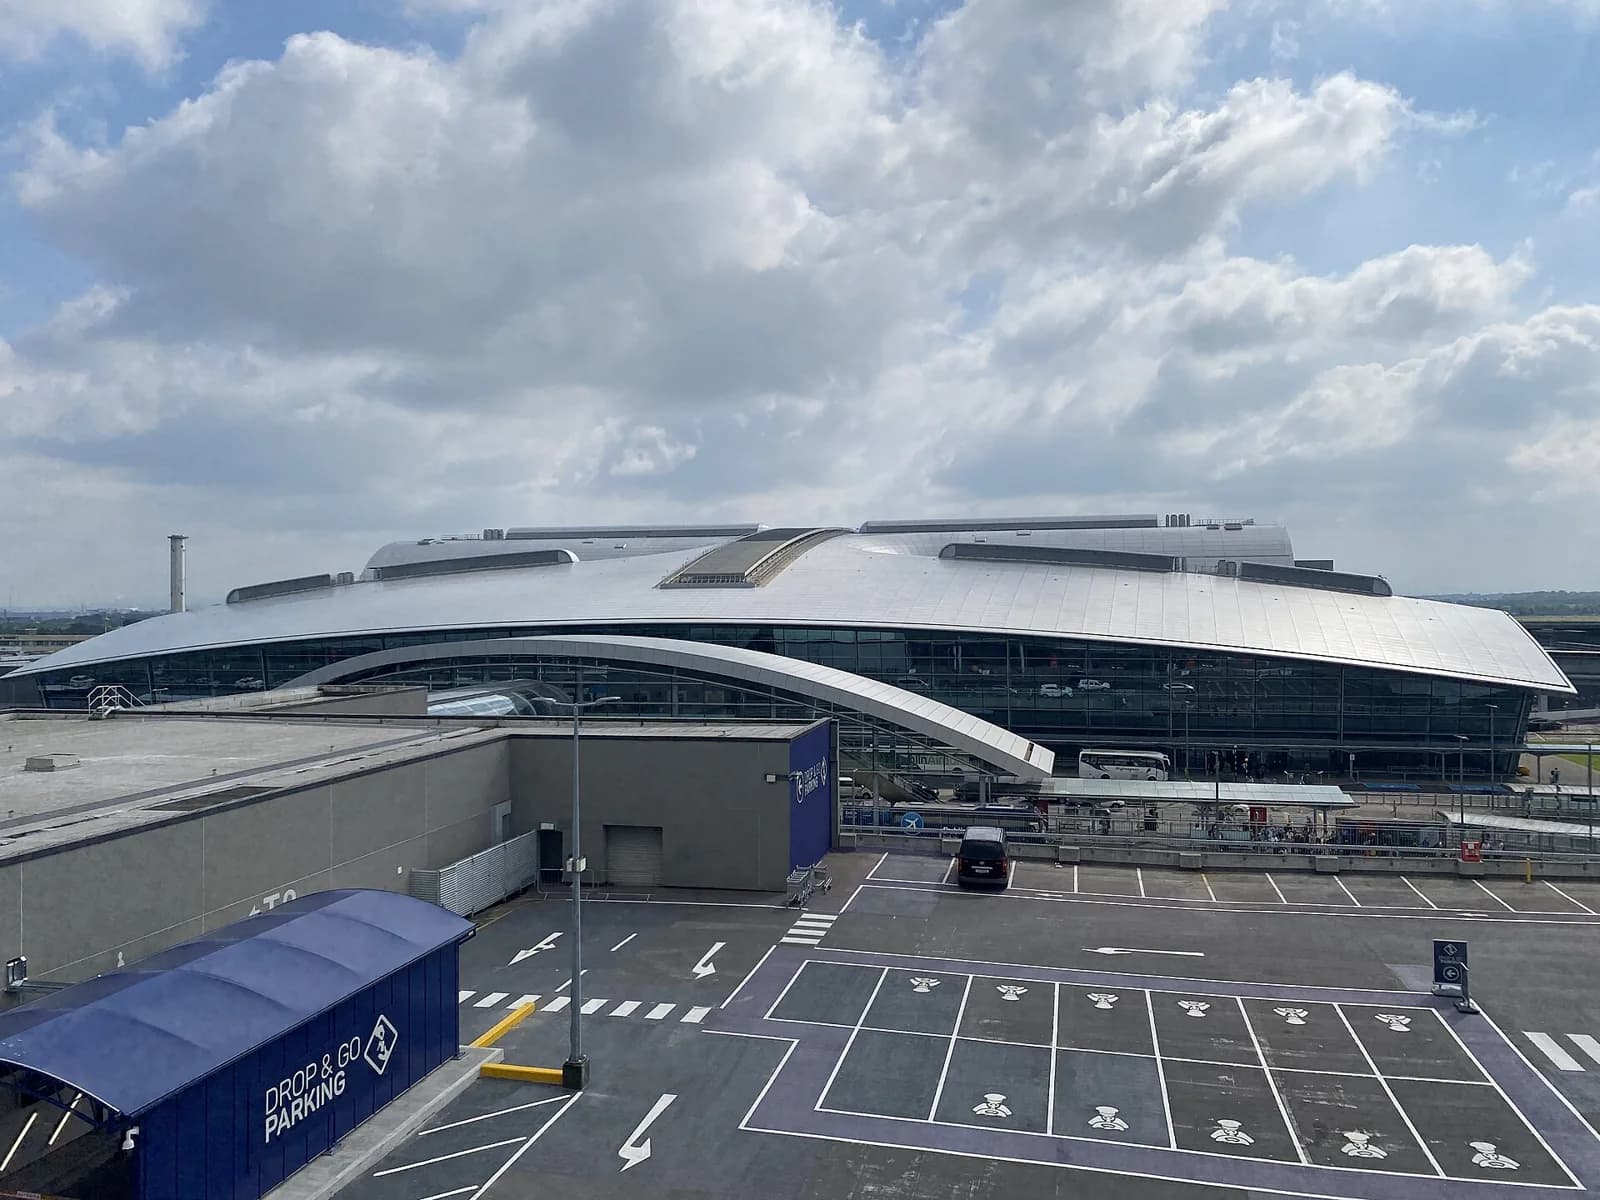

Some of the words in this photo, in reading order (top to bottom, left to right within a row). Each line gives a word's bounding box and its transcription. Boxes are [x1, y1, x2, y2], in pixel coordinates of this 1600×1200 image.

[265, 1070, 346, 1143] PARKING
[266, 1062, 317, 1115] DROP
[321, 1053, 334, 1079] &
[338, 1036, 361, 1068] GO
